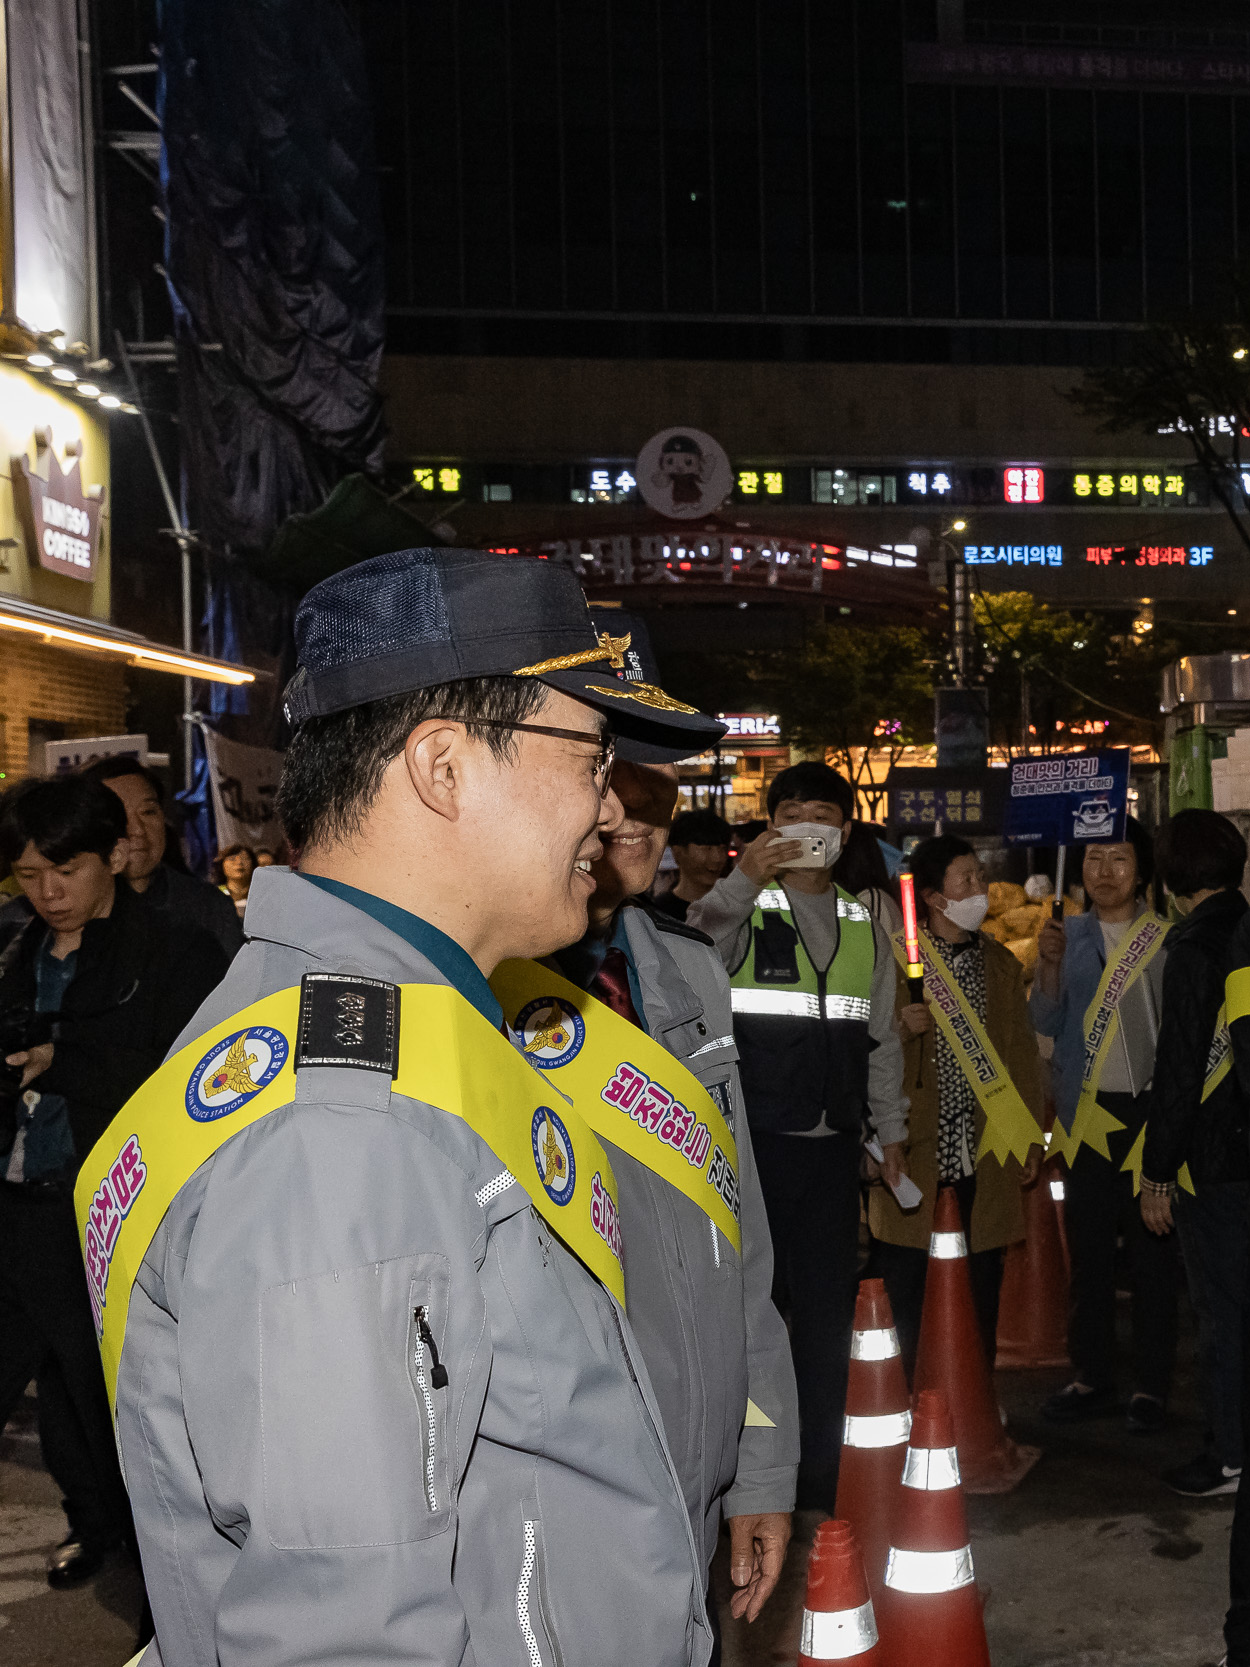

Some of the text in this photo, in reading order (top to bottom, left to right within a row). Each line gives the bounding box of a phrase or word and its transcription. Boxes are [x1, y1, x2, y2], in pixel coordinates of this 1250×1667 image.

[590, 470, 637, 493] 도수
[737, 471, 784, 495] 관절
[908, 472, 951, 495] 척추
[1073, 474, 1185, 497] 통증의학과
[43, 528, 91, 569] COFFEE
[963, 545, 1063, 566] 로즈시티의원
[1086, 546, 1126, 566] 피부
[1188, 546, 1214, 565] 3F
[1012, 757, 1099, 782] 건대맛의 거리!
[574, 1025, 584, 1047] POLICE
[254, 1028, 285, 1080] 서울광진경찰서
[188, 1039, 244, 1119] SEOUL GWANGJIN POLICE STATION
[970, 1050, 999, 1085] 거리
[599, 1062, 712, 1169] 범죄없는
